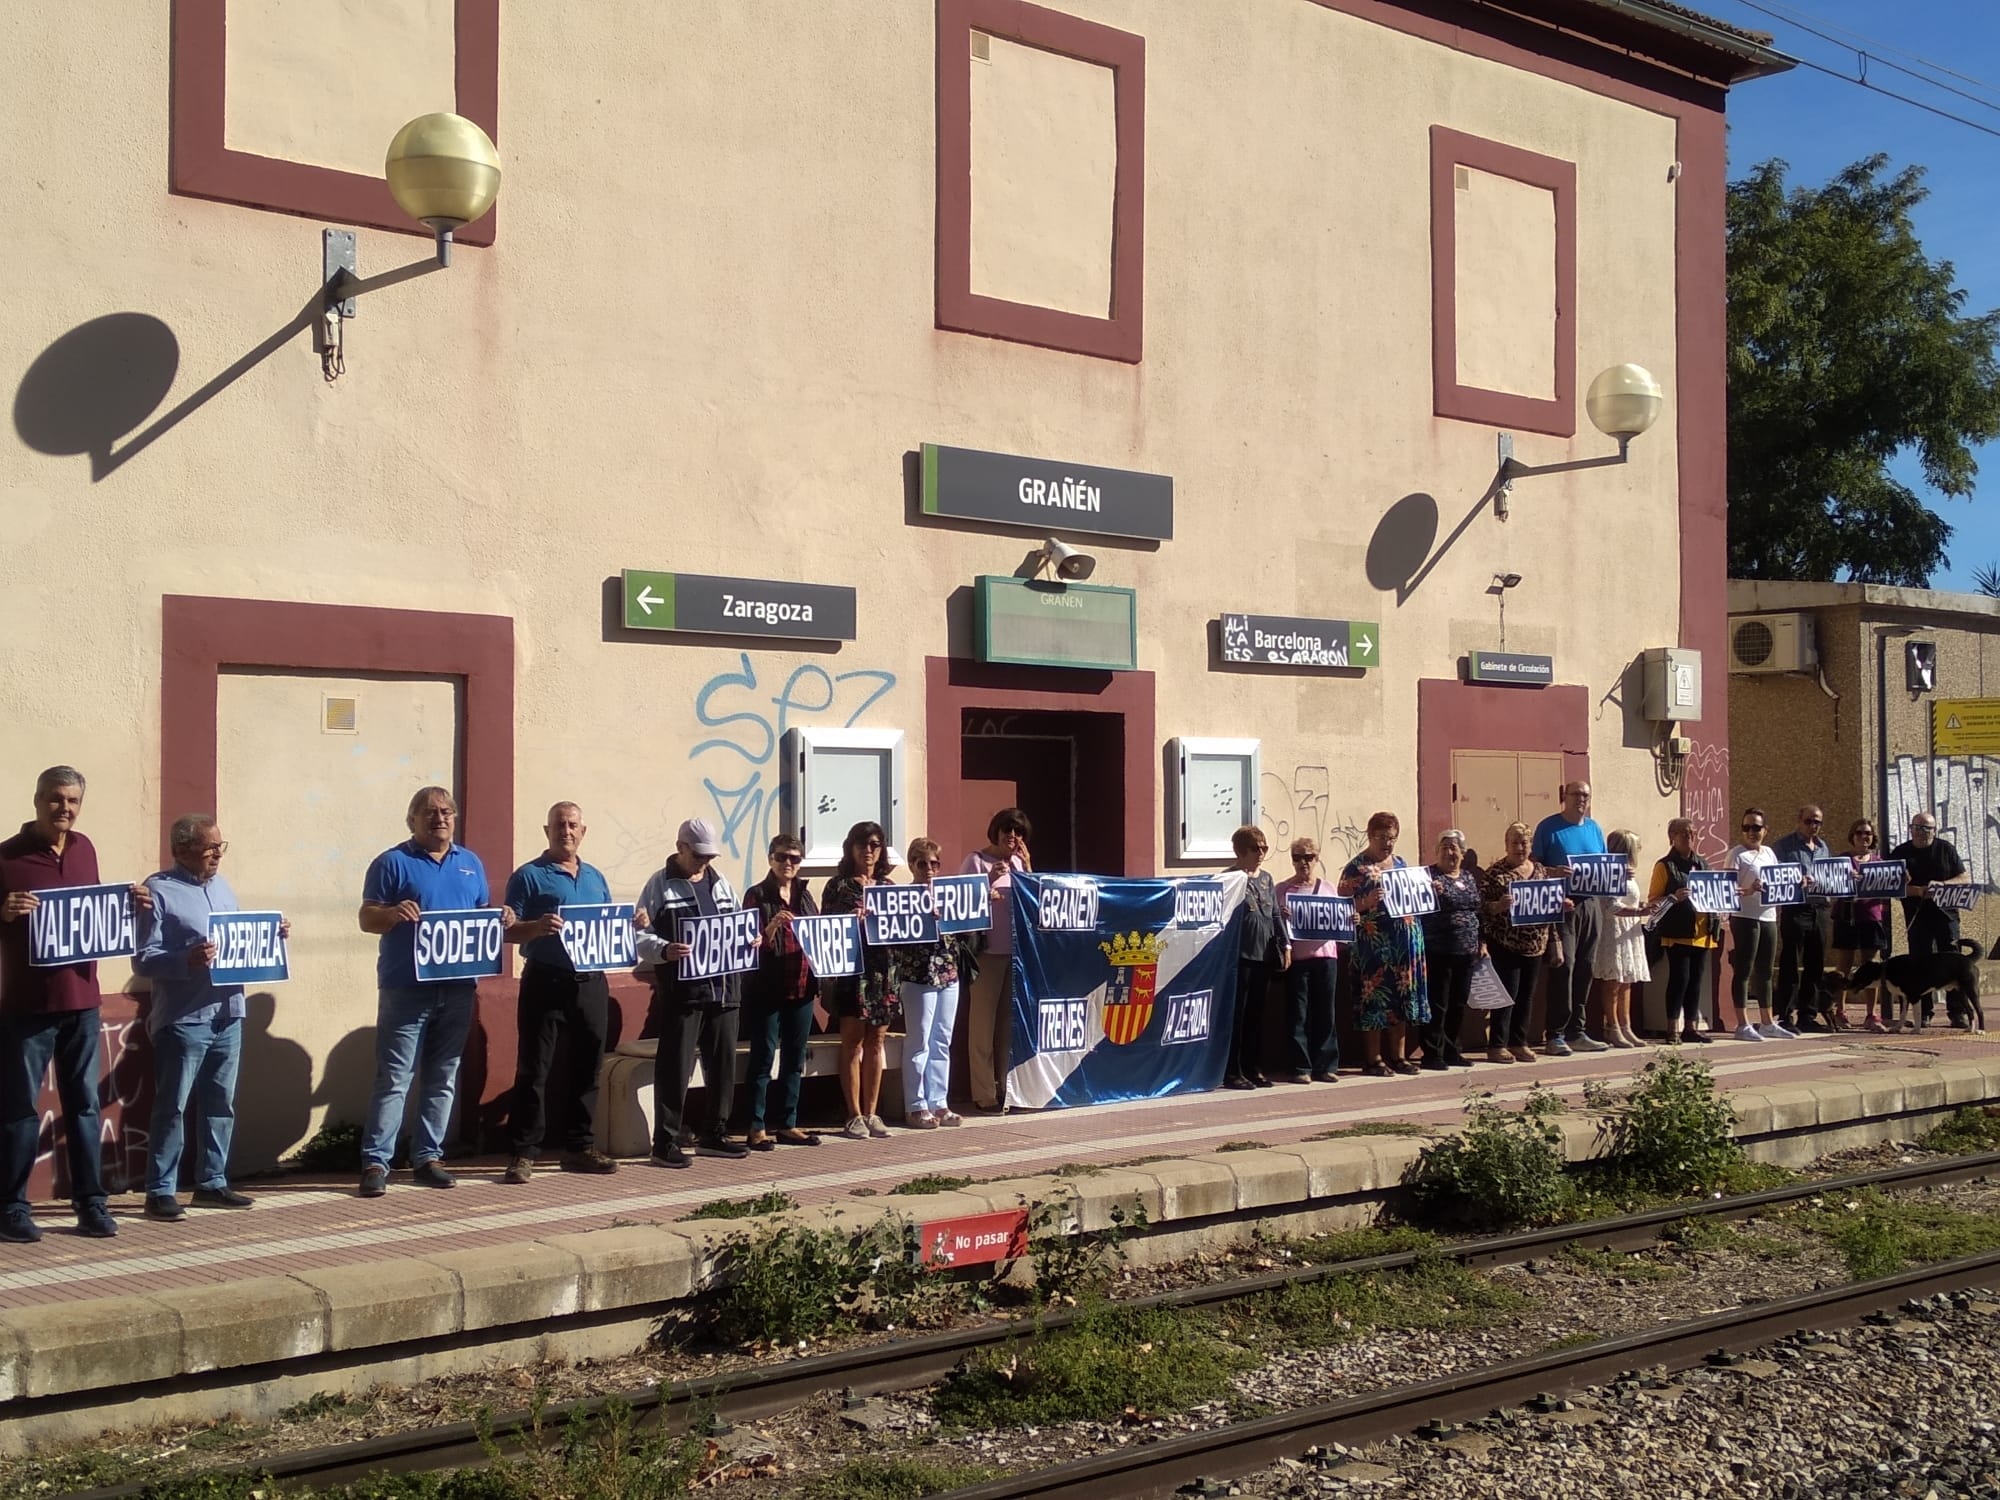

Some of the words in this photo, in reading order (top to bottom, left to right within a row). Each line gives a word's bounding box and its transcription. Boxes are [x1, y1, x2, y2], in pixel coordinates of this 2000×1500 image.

[1019, 476, 1100, 513] GRAÑÉN
[722, 594, 813, 625] Zaragoza
[1255, 630, 1321, 651] Barcelona
[1480, 661, 1508, 672] Gabinete
[1509, 663, 1517, 673] de
[1518, 663, 1550, 674] Circulación
[1382, 866, 1436, 916] ROBRES
[1570, 856, 1627, 893] GRAÑÉN
[1761, 866, 1802, 886] ALBERO
[1861, 866, 1903, 892] TORRES
[866, 889, 933, 915] ALBERO
[934, 882, 989, 921] FRULA
[1175, 889, 1223, 924] QUEREMOS
[1510, 884, 1564, 917] PIRACES
[1768, 884, 1795, 902] BAJO
[32, 891, 134, 959] VALFONDA
[417, 918, 500, 966] SODETO
[560, 906, 636, 966] GRAÑÉN
[878, 914, 923, 940] BAJO
[210, 921, 284, 969] ALBERUELA
[683, 912, 756, 977] ROBRES
[798, 917, 855, 975] CURBE
[1040, 1004, 1085, 1049] TRENES
[955, 1235, 970, 1250] No
[975, 1231, 1009, 1250] pasar
